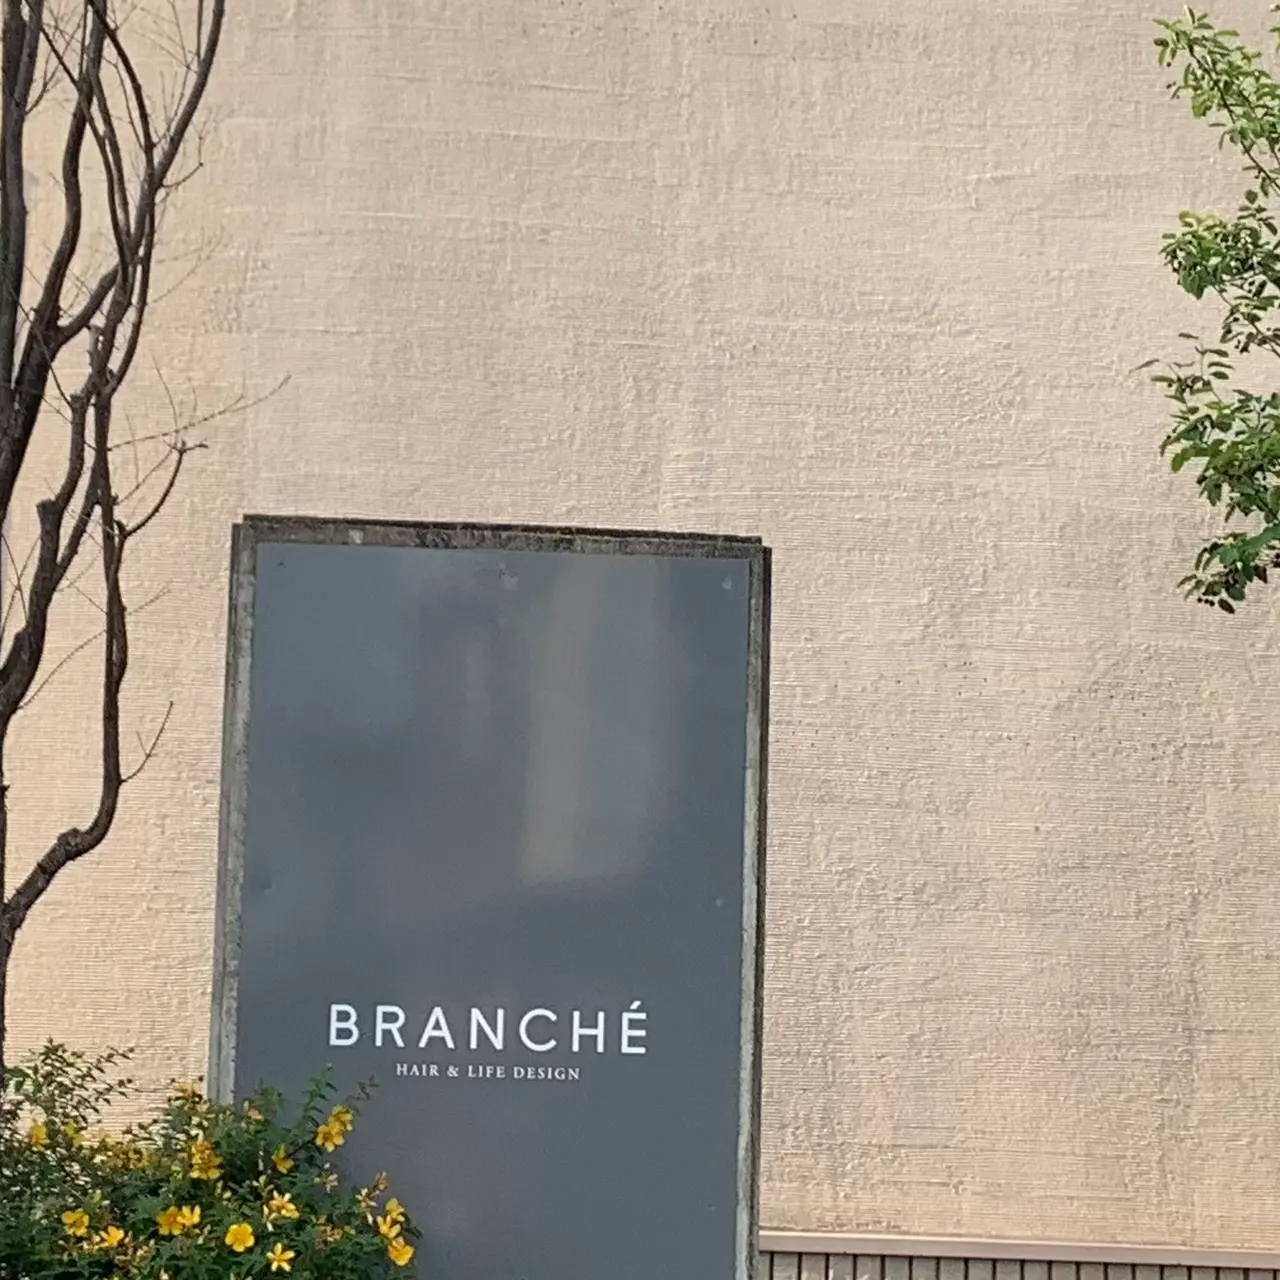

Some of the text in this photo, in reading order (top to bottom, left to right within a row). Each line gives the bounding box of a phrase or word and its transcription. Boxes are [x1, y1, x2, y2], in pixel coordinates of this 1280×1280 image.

[328, 1000, 648, 1055] BRANCHÉ
[395, 1063, 581, 1081] HAIR & LIFE DESIGN
